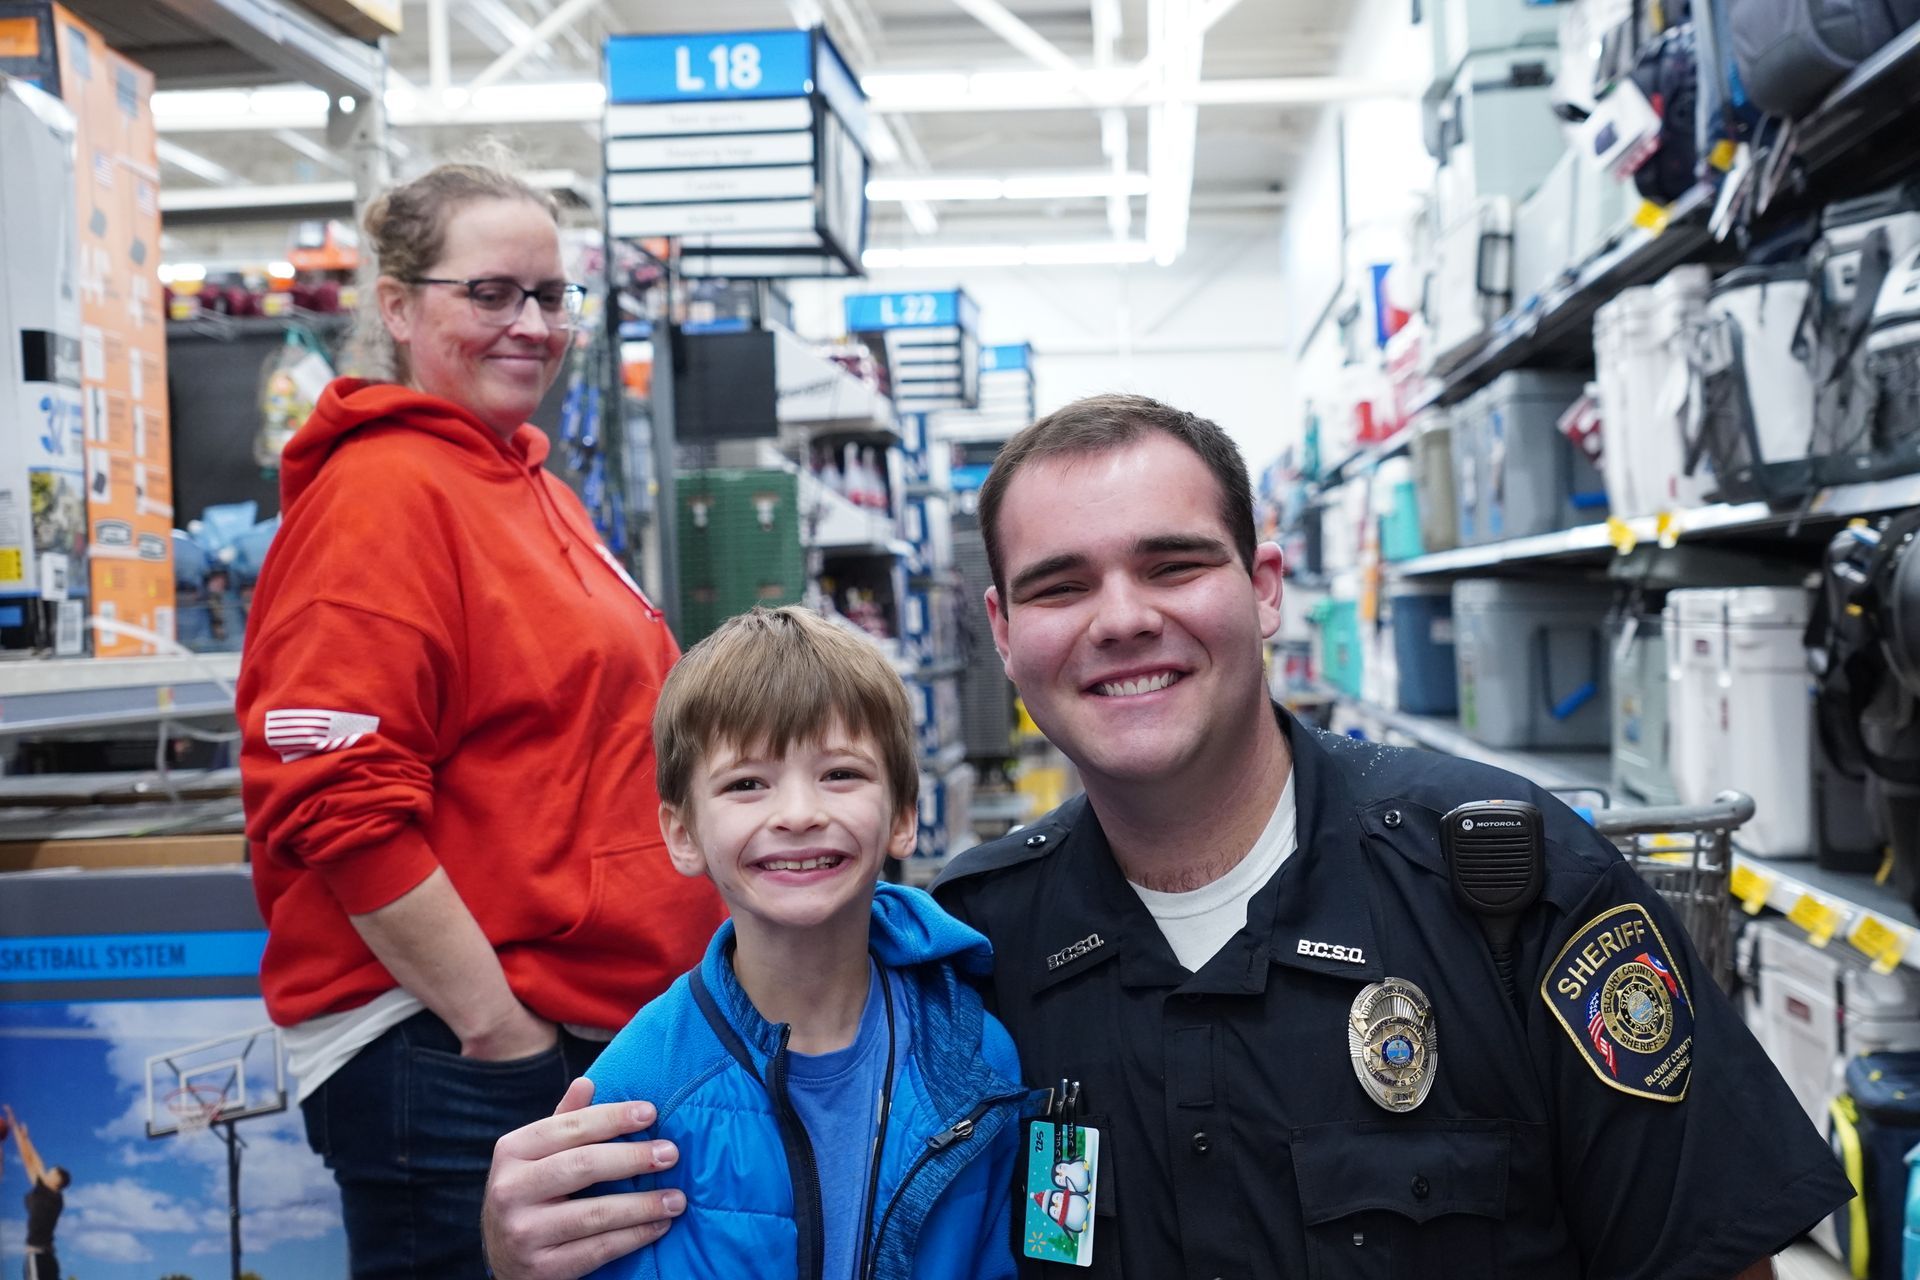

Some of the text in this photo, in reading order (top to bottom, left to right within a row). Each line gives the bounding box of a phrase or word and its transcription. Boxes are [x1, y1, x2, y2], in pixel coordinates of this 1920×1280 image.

[675, 43, 762, 91] L 18
[880, 295, 937, 325] L 22
[105, 942, 187, 968] SYSTEM
[1297, 939, 1366, 964] B.C.S.O.
[1557, 920, 1645, 1000] SHERIFF
[1603, 965, 1655, 1014] BLOUNT COUNTY
[1621, 984, 1637, 1009] STATE
[1364, 1018, 1392, 1047] BLOUNT
[1620, 1033, 1666, 1051] SHERIFF'S
[1644, 1035, 1693, 1087] BLOUNT COUNTY
